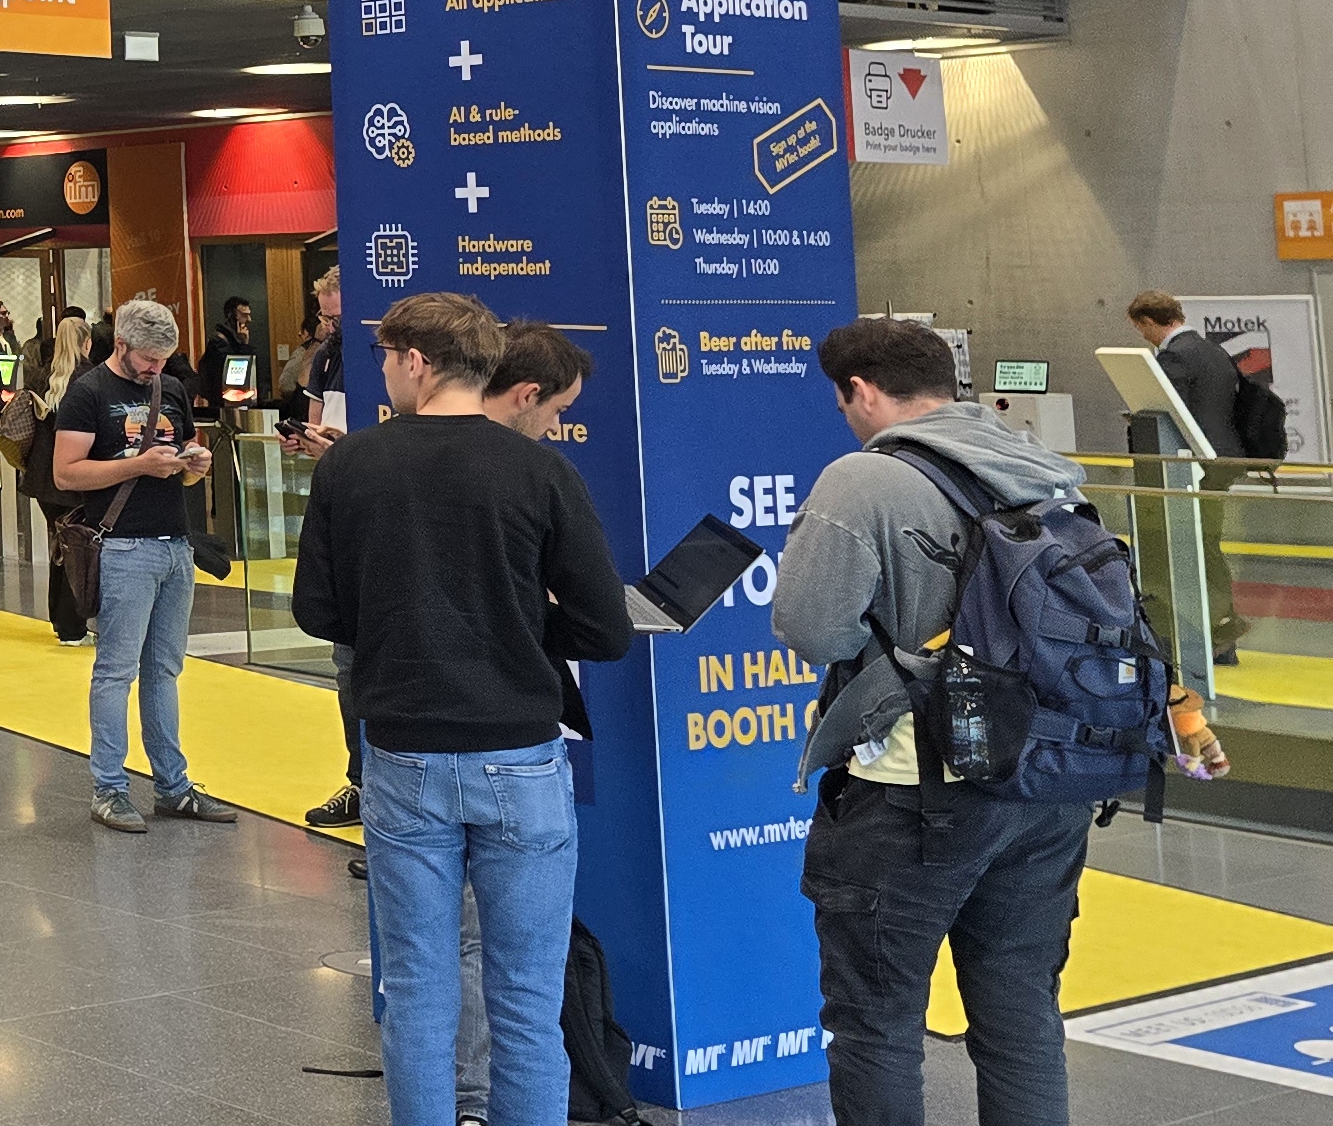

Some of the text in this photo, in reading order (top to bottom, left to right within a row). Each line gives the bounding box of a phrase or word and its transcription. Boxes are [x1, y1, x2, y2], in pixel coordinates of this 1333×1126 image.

[681, 25, 733, 56] Tour
[485, 103, 519, 122] rule-
[649, 91, 781, 115] Discover machine vision
[450, 124, 561, 147] based methods
[650, 118, 719, 138] applications
[864, 122, 937, 141] Badge Drucker
[865, 140, 937, 156] Print your badge here
[692, 198, 771, 220] Tuesday 14:00
[457, 235, 533, 254] Hardware
[693, 228, 831, 250] Wednesday 10:00 14:00
[459, 258, 551, 280] independent
[695, 258, 779, 279] Thursday 10:00
[1204, 316, 1267, 331] Motek
[700, 331, 811, 352] Beer after five
[701, 358, 807, 379] Tuesday Wednesday
[730, 475, 796, 529] SEE
[699, 654, 734, 693] IN
[687, 703, 795, 750] BOOTH
